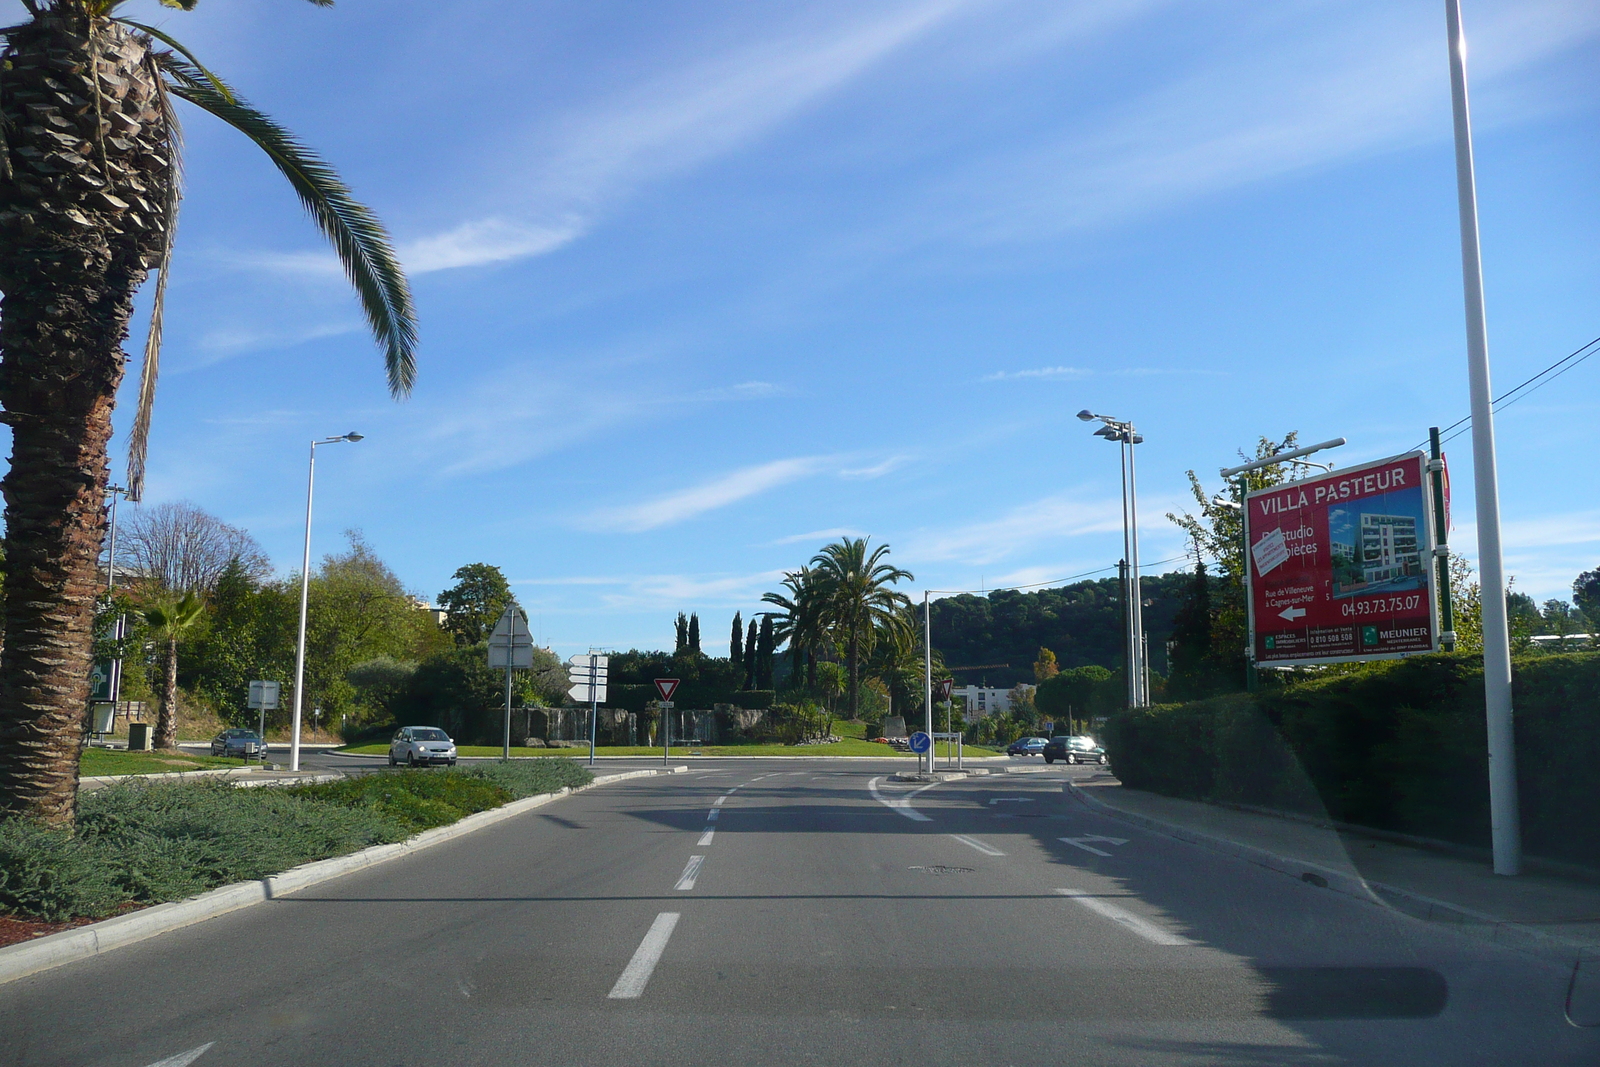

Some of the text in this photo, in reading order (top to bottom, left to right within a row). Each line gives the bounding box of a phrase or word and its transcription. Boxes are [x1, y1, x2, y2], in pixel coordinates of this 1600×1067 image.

[1260, 467, 1406, 515] VILLA PASTEUR
[1282, 524, 1314, 542] studio
[1265, 586, 1314, 598] Rue de Villeneuve
[1265, 595, 1314, 608] à Cagnes-sur-Mer
[1341, 595, 1420, 617] 04.93.73.75.07
[1310, 633, 1353, 644] 0 810 508 508
[1380, 628, 1427, 639] MEUNIER
